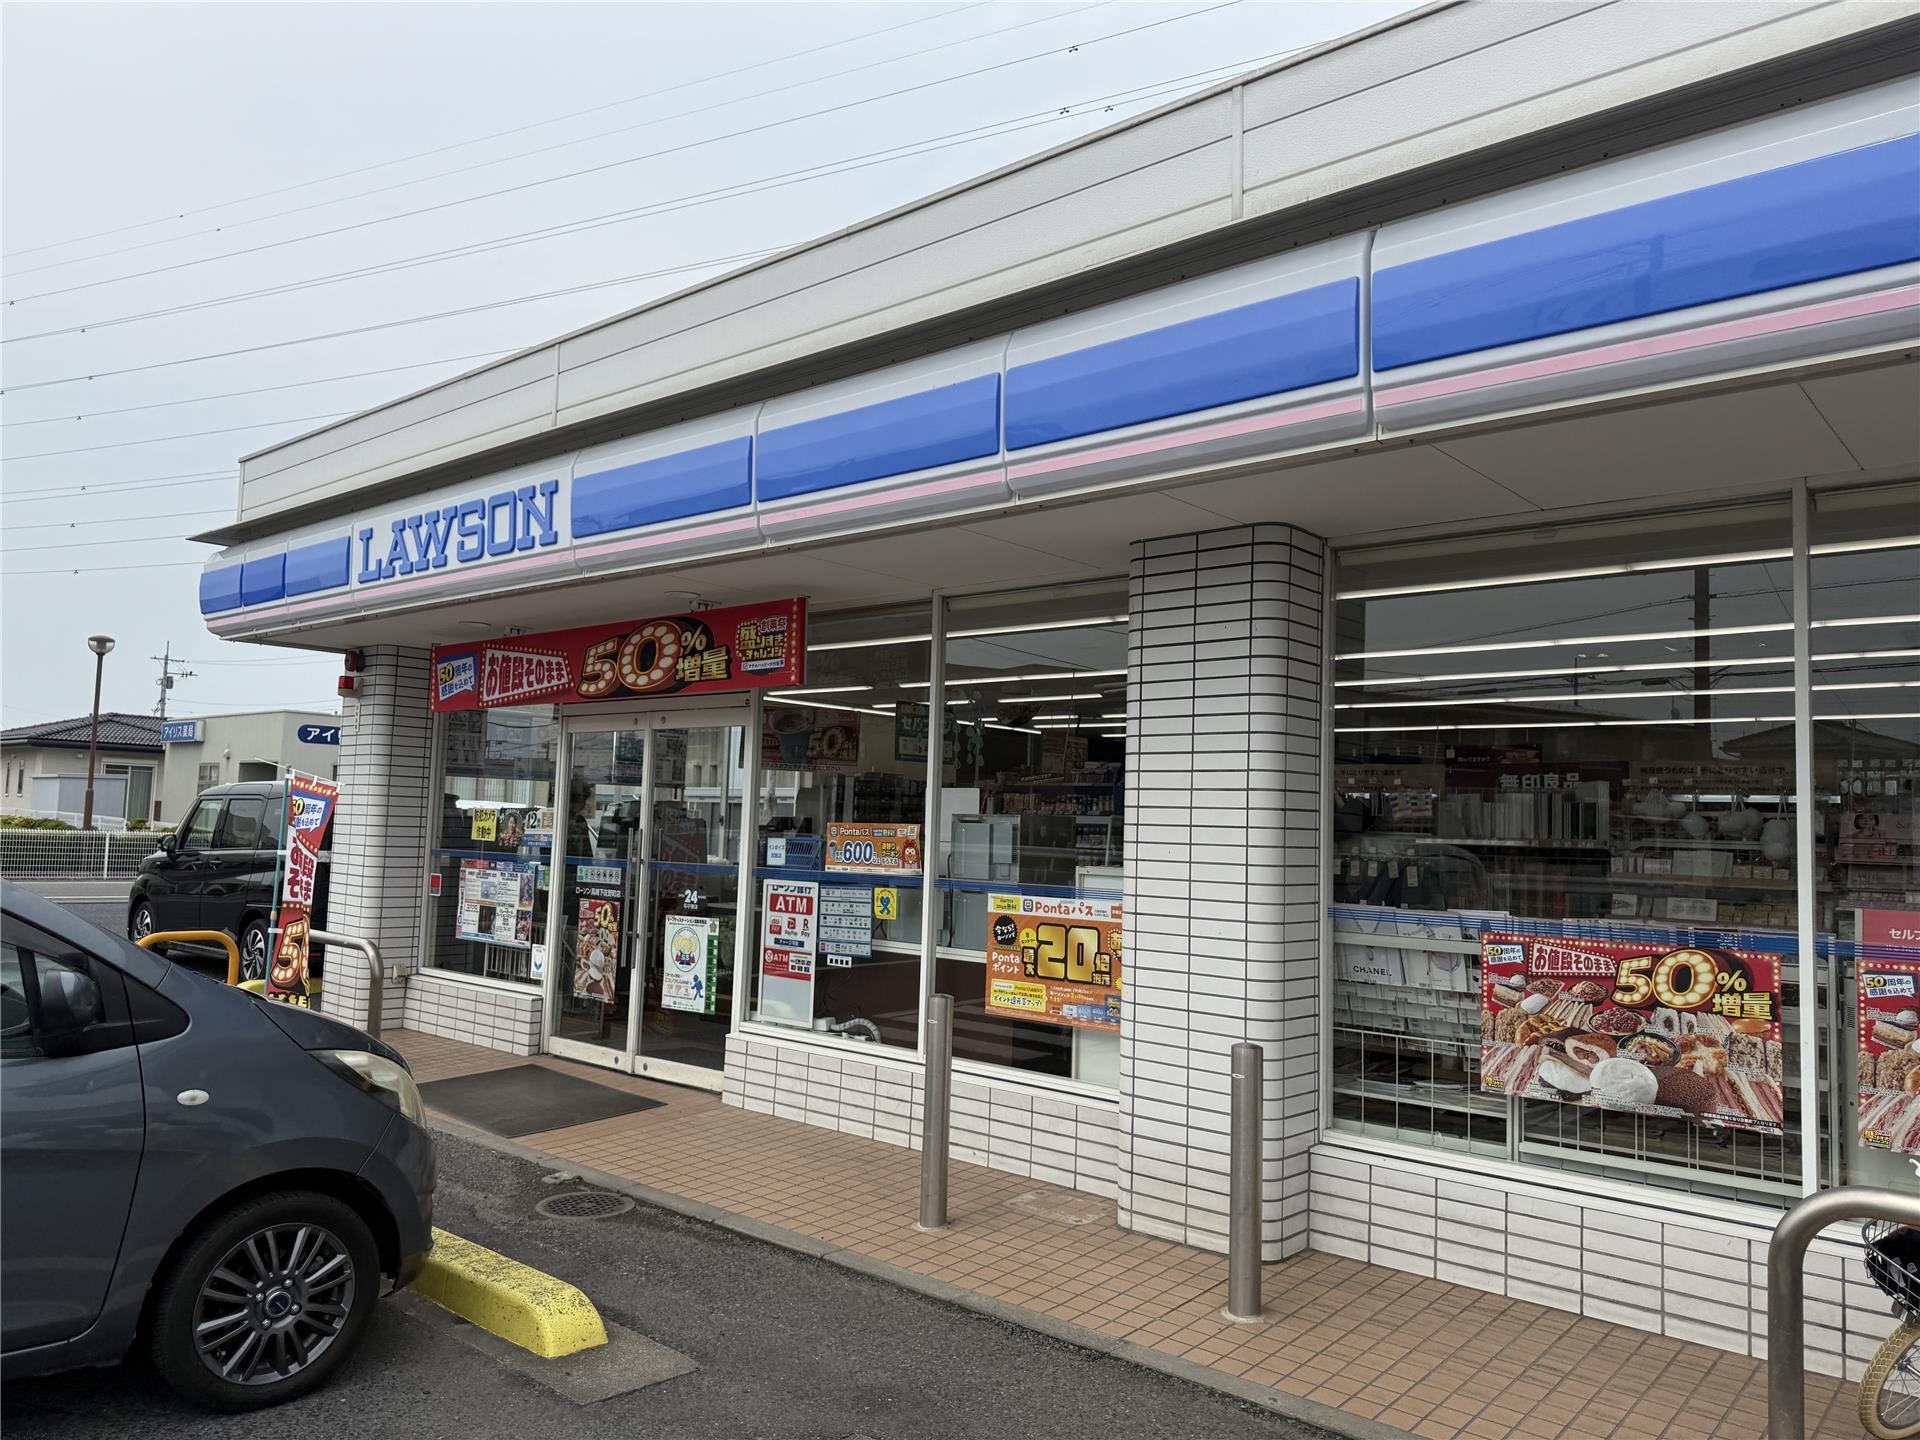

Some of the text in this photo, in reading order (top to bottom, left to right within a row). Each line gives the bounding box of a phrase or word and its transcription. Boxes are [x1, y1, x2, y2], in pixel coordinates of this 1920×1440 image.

[358, 480, 559, 584] LAWSON
[740, 625, 784, 650] 盛りすぎ
[745, 647, 783, 660] チャレンジ
[675, 646, 729, 683] 増量
[440, 662, 474, 686] 50周年の
[485, 652, 565, 697] お値段そのまま
[441, 676, 474, 697] 感謝を込めて
[163, 724, 194, 739] アイリス薬局
[840, 827, 870, 837] Pontaパス
[843, 840, 874, 865] 600
[684, 889, 699, 904] 24
[776, 895, 808, 914] ATM
[1034, 901, 1093, 916] Pontaパス
[801, 930, 811, 938] Pay
[995, 923, 1015, 935] 今なら!
[997, 931, 1016, 941] ローソンで
[773, 953, 788, 963] ATM
[992, 951, 1020, 964] Ponta
[1038, 924, 1098, 983] 20
[1488, 945, 1522, 957] 50周年の
[1490, 955, 1523, 964] 感謝を込めて
[1535, 945, 1614, 973] お値段そのまま
[992, 961, 1020, 975] ポイント
[1353, 965, 1392, 977] CHANEL
[1866, 976, 1912, 989] 50周年の
[1869, 988, 1913, 997] 感謝を込めて
[1712, 991, 1772, 1020] 増量
